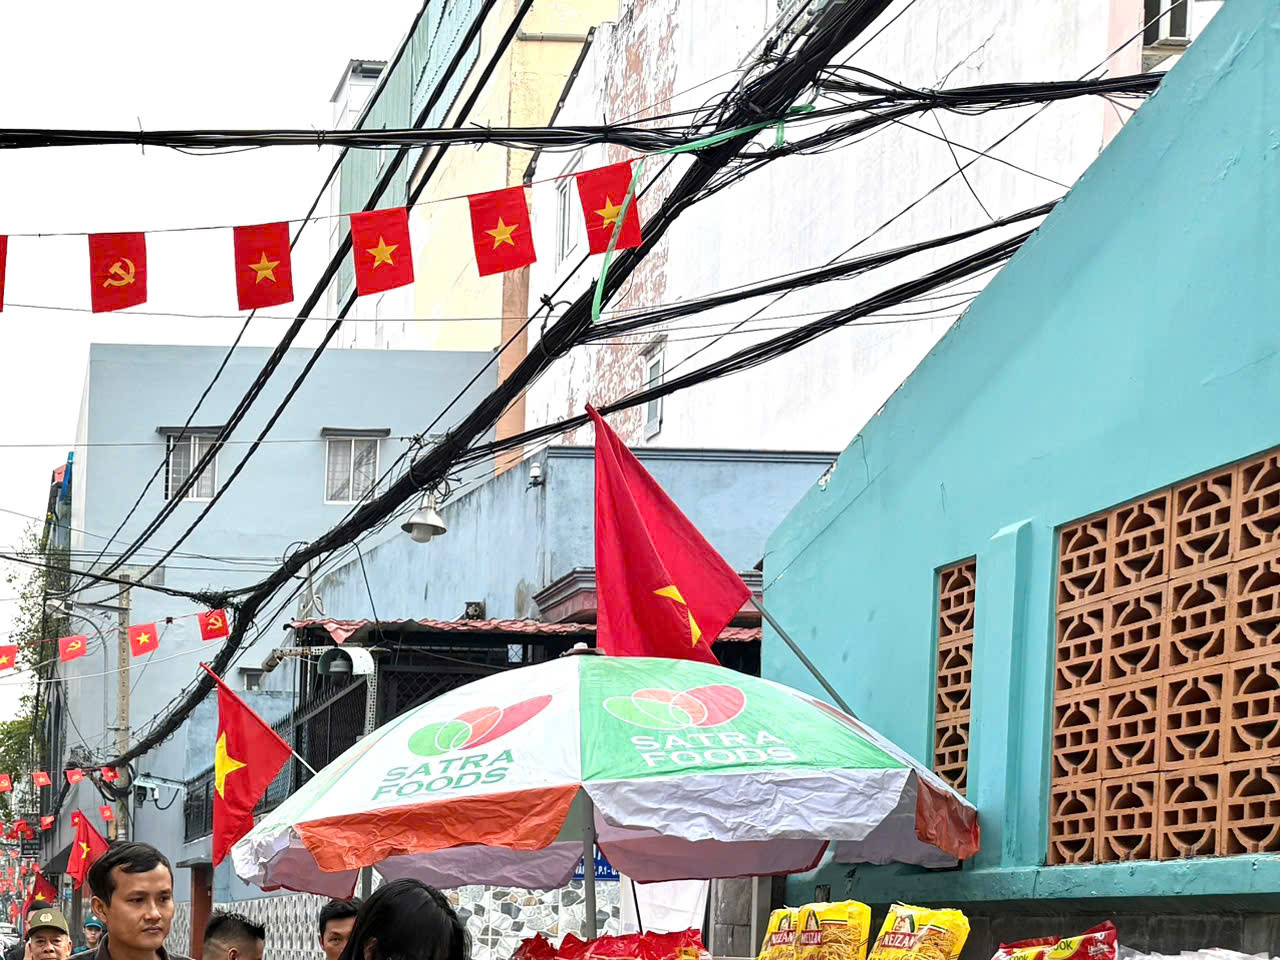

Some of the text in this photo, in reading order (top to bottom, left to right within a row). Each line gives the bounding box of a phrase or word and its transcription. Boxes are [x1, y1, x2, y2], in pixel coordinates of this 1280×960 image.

[631, 729, 786, 751] SATRA
[384, 748, 515, 783] SATRA
[642, 747, 799, 768] FOODS
[372, 767, 509, 801] FOODS
